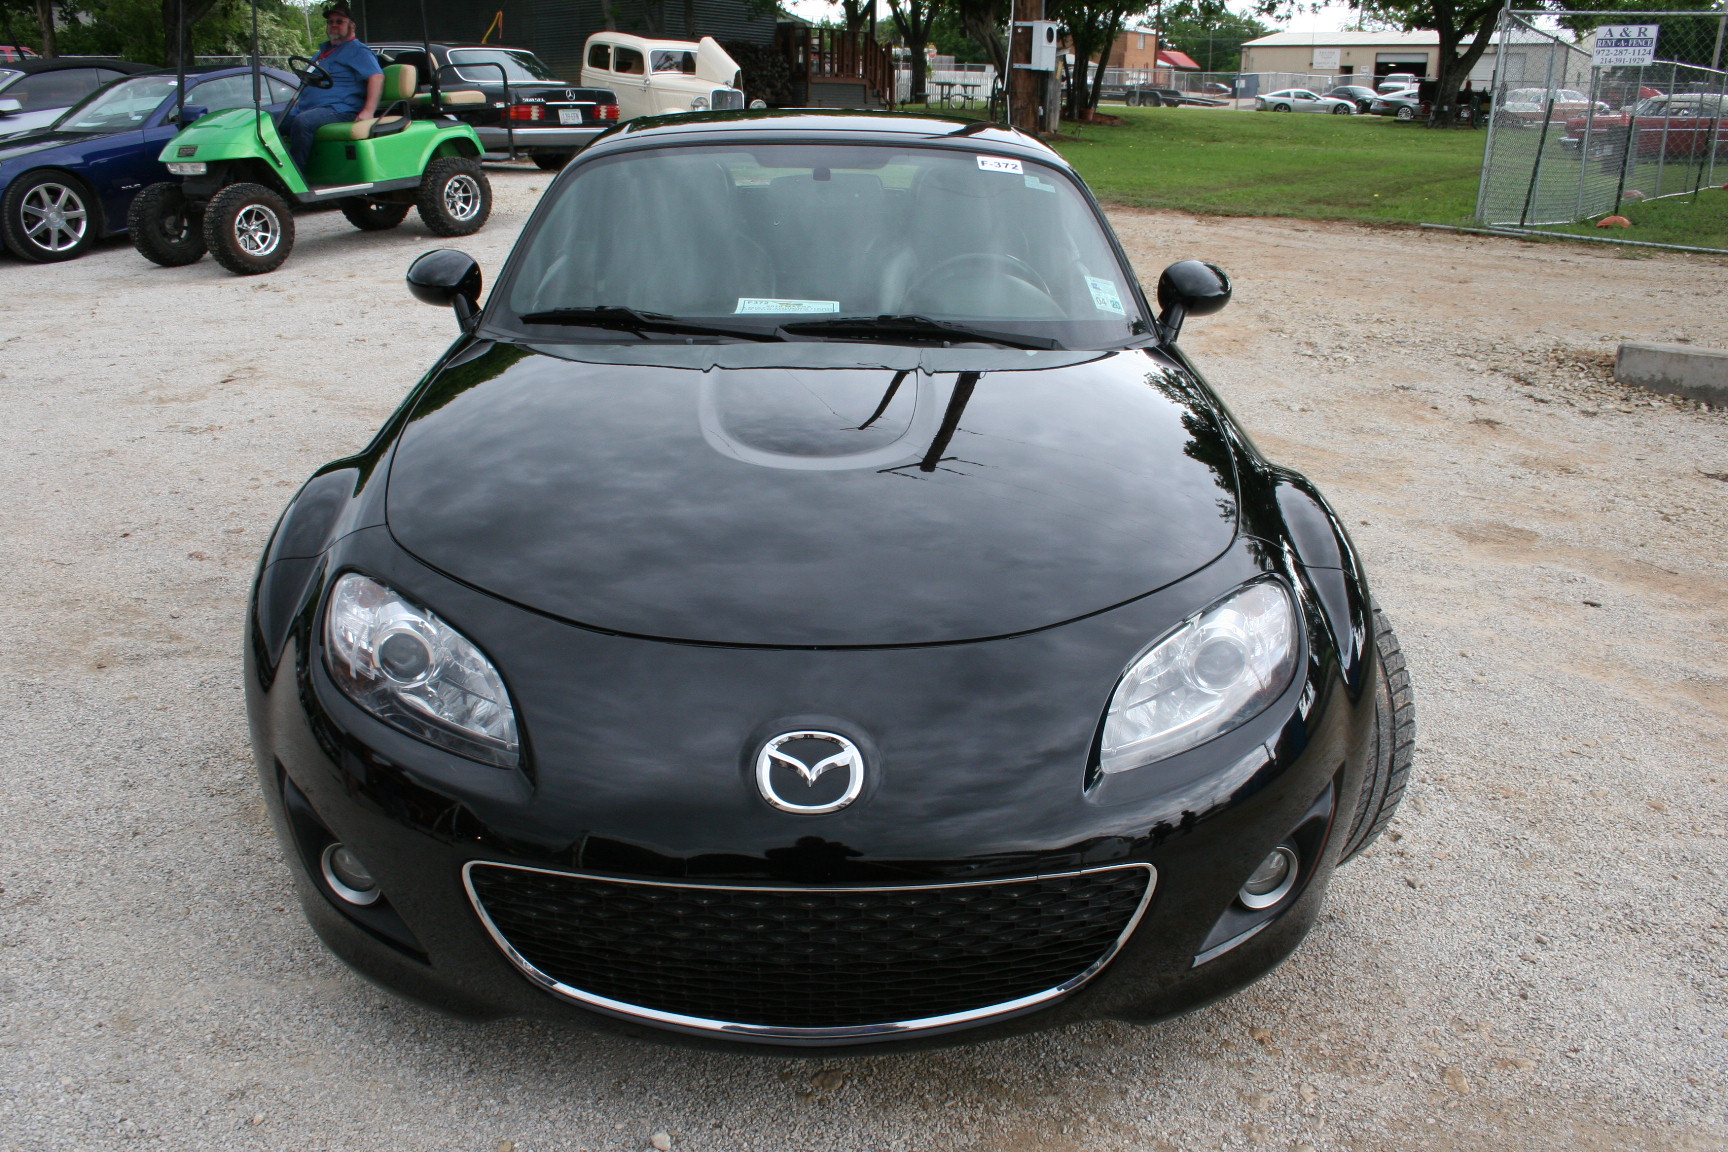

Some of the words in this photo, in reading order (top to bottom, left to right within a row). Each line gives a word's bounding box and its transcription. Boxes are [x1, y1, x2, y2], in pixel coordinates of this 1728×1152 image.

[1604, 28, 1613, 37] A
[1620, 27, 1632, 37] &
[1637, 27, 1648, 37] R
[1597, 39, 1616, 47] RENT
[1628, 38, 1652, 47] FENCE
[1595, 48, 1652, 57] 972-287-1124
[1599, 57, 1645, 65] 214-391-1929
[980, 160, 1020, 171] F-372
